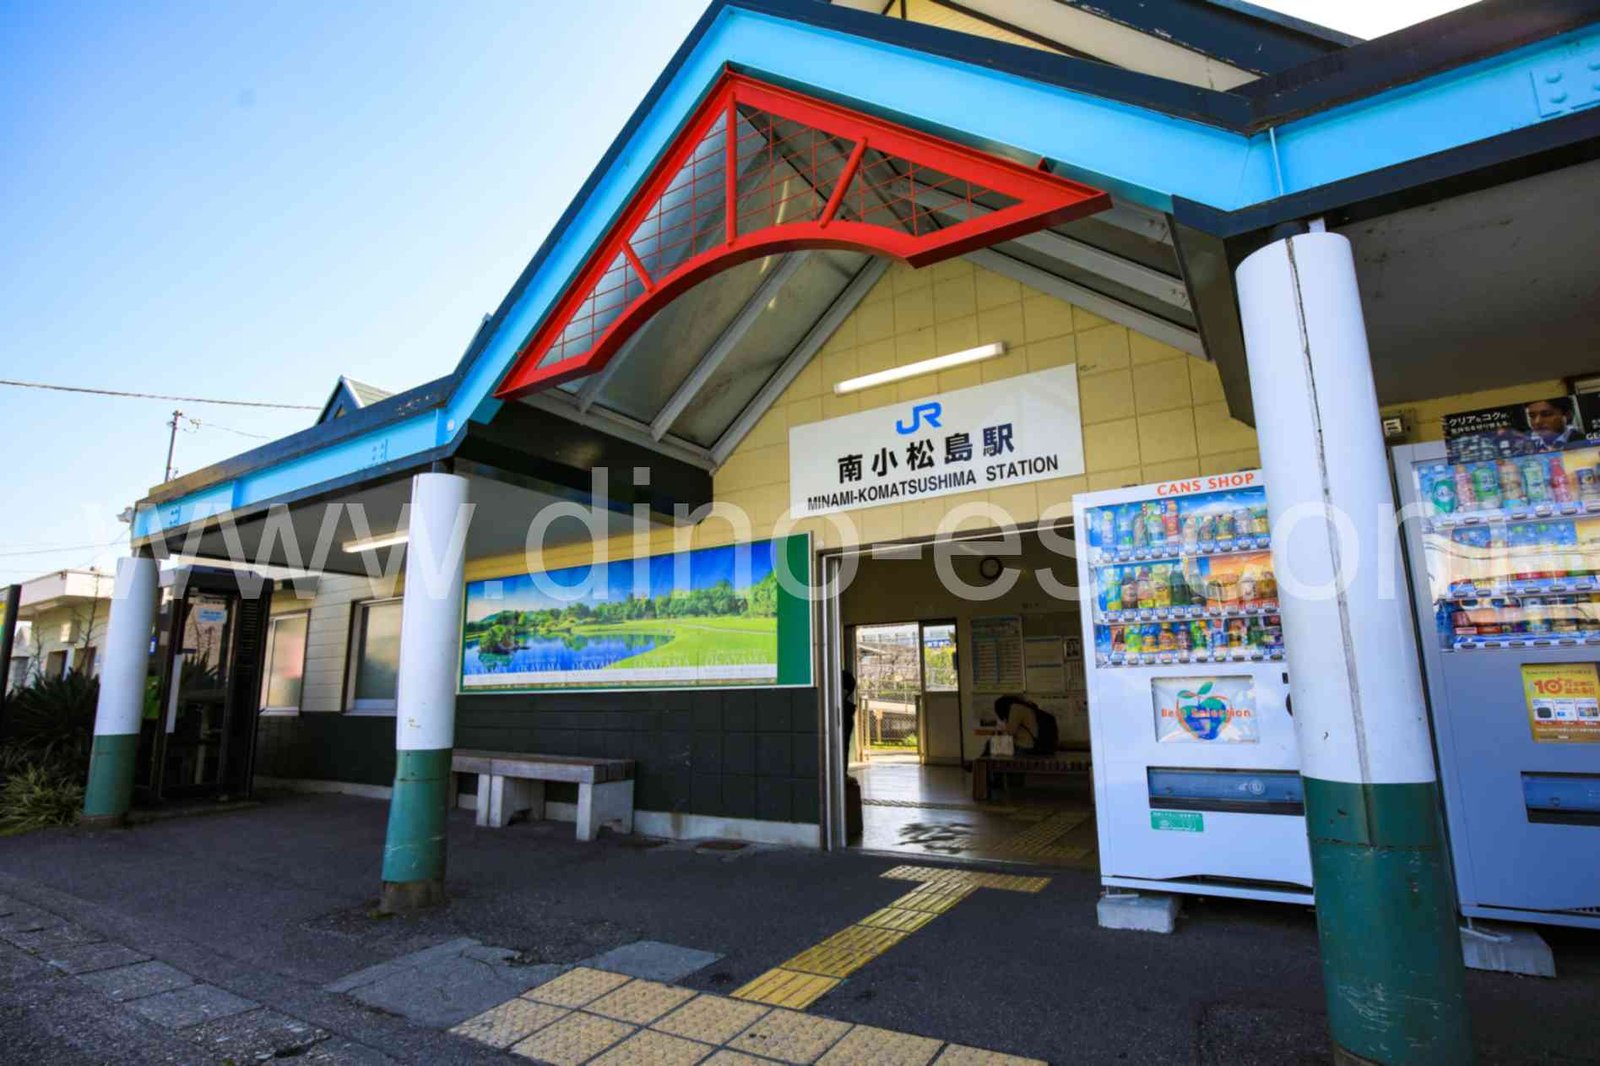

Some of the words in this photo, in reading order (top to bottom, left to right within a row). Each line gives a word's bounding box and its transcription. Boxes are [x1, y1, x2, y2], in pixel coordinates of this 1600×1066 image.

[896, 401, 942, 435] JR
[837, 423, 1015, 484] 南小松島駅
[807, 469, 976, 511] MINAMI-KOMATSUSHIMA
[986, 454, 1059, 482] STATION
[1157, 480, 1201, 496] CANS
[1207, 472, 1254, 490] SHOP
